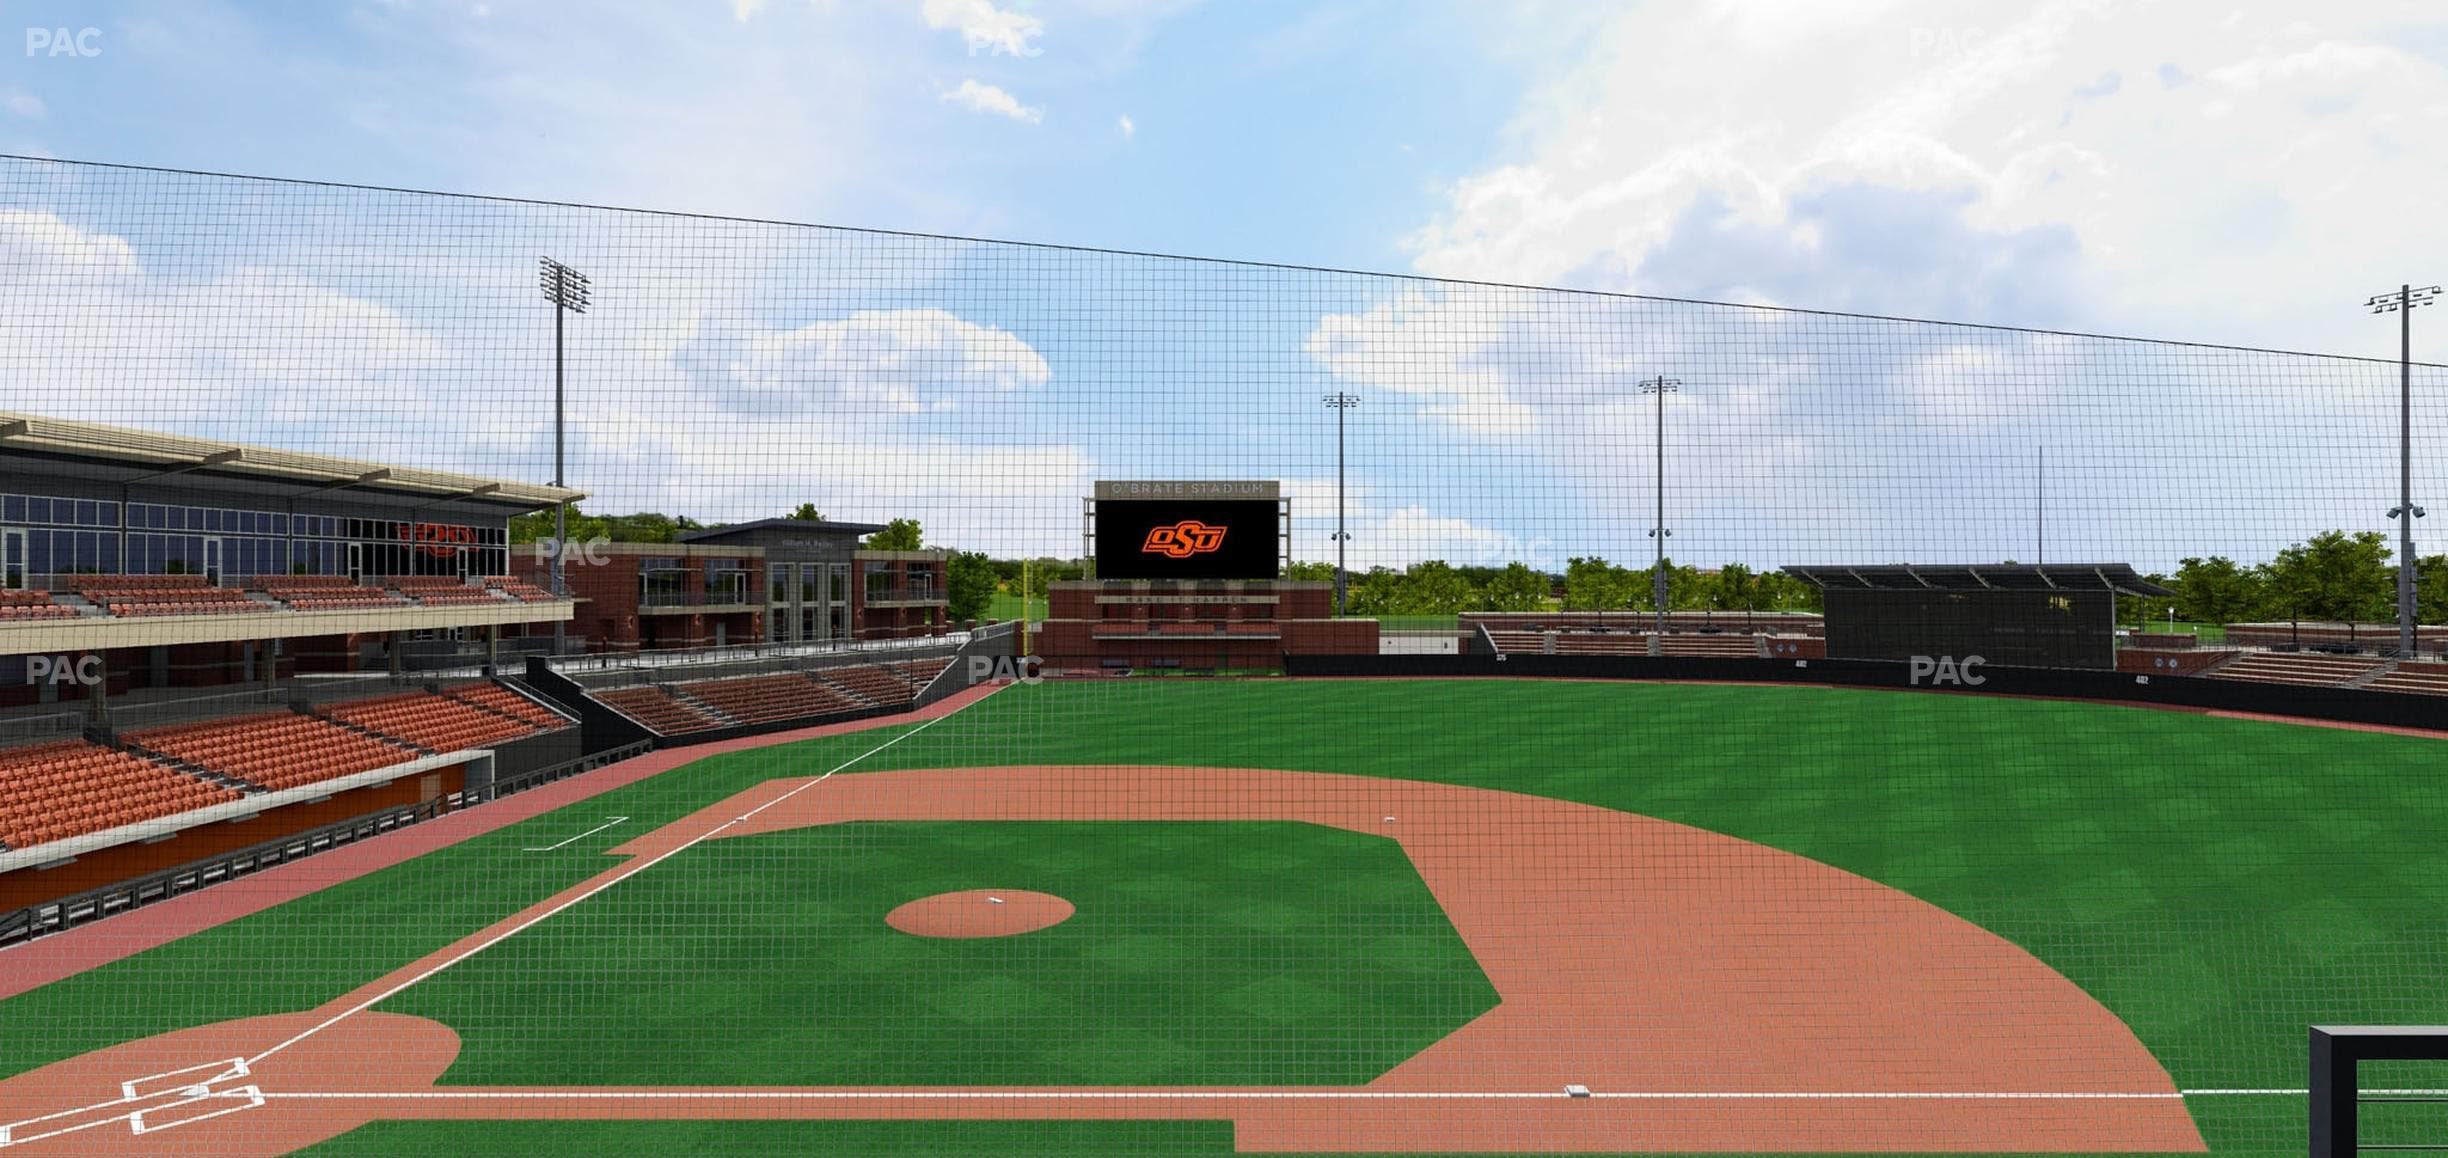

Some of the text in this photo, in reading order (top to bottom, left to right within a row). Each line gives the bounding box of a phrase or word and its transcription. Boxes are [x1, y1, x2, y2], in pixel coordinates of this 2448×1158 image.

[1111, 483, 1264, 495] O'BRATE STADIUM
[1145, 521, 1225, 557] OSU
